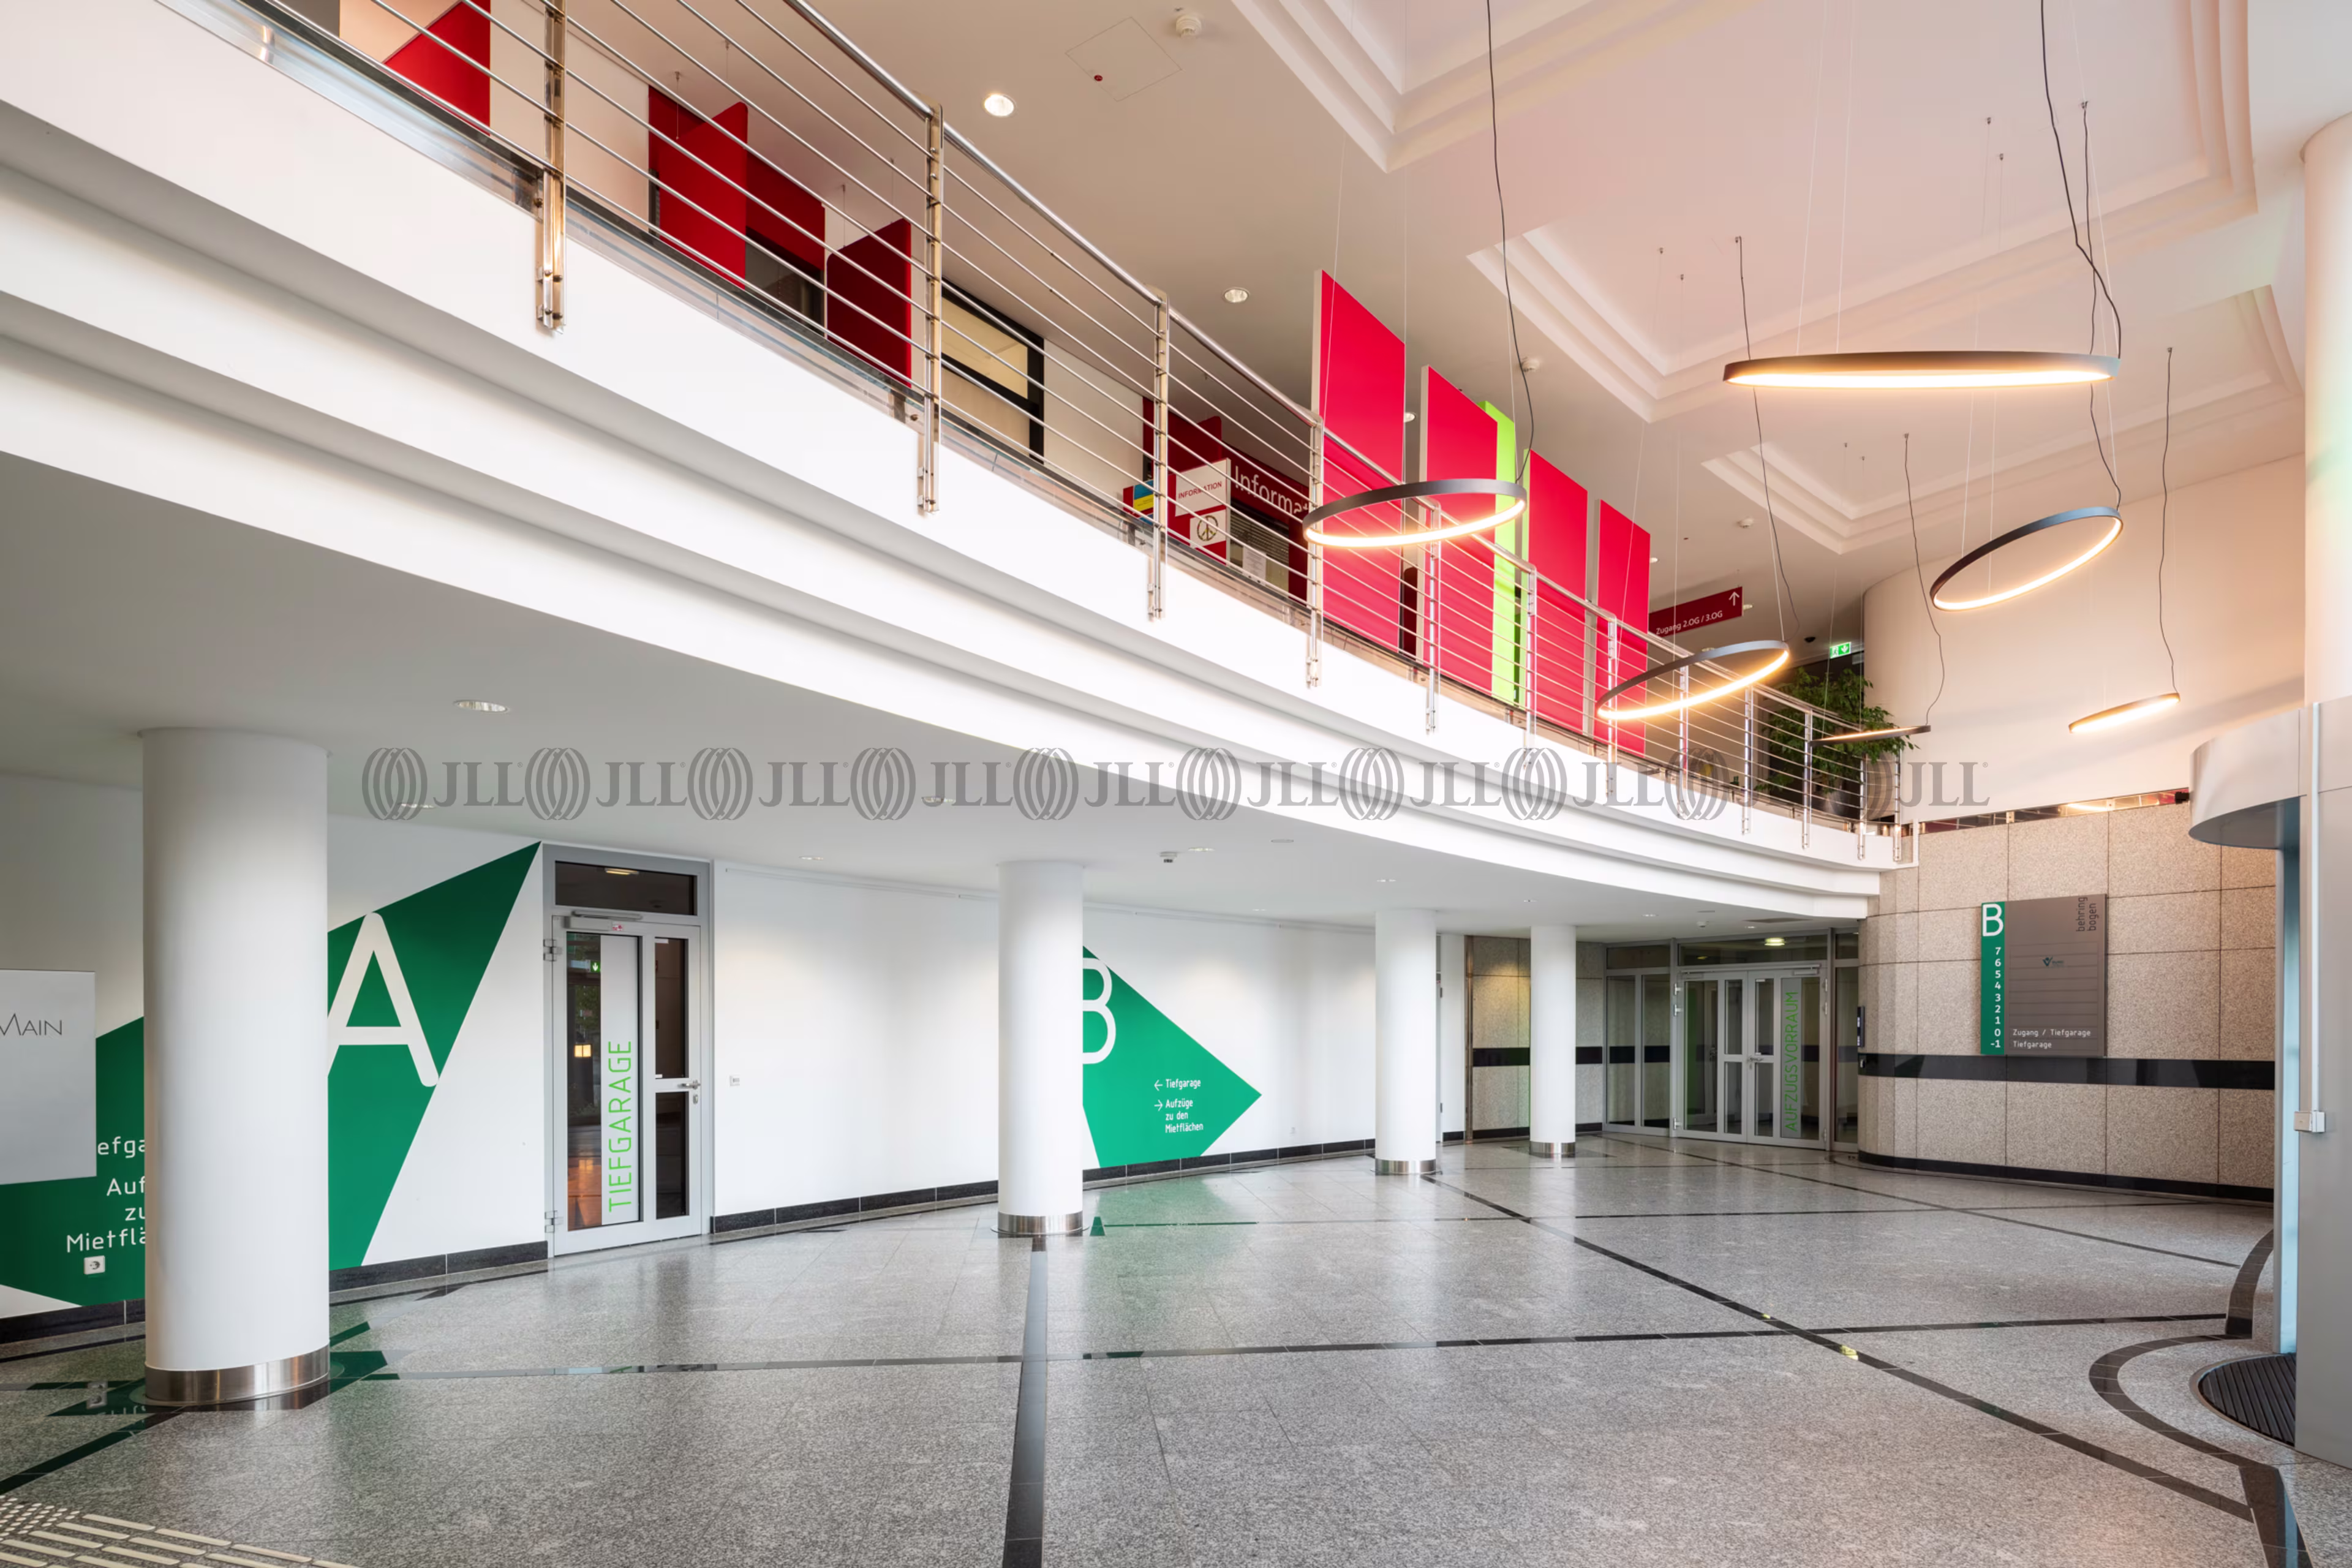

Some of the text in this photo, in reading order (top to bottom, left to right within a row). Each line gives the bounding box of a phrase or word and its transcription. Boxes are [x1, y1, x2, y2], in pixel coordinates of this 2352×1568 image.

[1178, 481, 1222, 499] INFORMATION
[1656, 624, 1681, 635] Zugang
[1683, 616, 1700, 628] 2.OG
[1705, 610, 1723, 622] 3.OG
[1982, 903, 2003, 937] B
[2075, 897, 2088, 932] behring
[2087, 903, 2099, 931] bogen
[328, 912, 439, 1087] A
[1991, 1039, 2052, 1049] -1 Tiefgarage
[1994, 1028, 2001, 1037] 0
[2013, 1029, 2038, 1038] Zugang
[2049, 1028, 2091, 1038] Tiefgarage
[1784, 991, 1799, 1133] AUFZUGSVORRAUM
[1166, 1078, 1201, 1090] Tiefgarage
[1166, 1098, 1193, 1109] Aufzüge
[1176, 1110, 1188, 1120] den
[608, 1041, 631, 1212] TIEFGARAGE
[1164, 1122, 1204, 1133] Mietflächen
[106, 1175, 145, 1197] Auf
[66, 1227, 146, 1253] Mietflä
